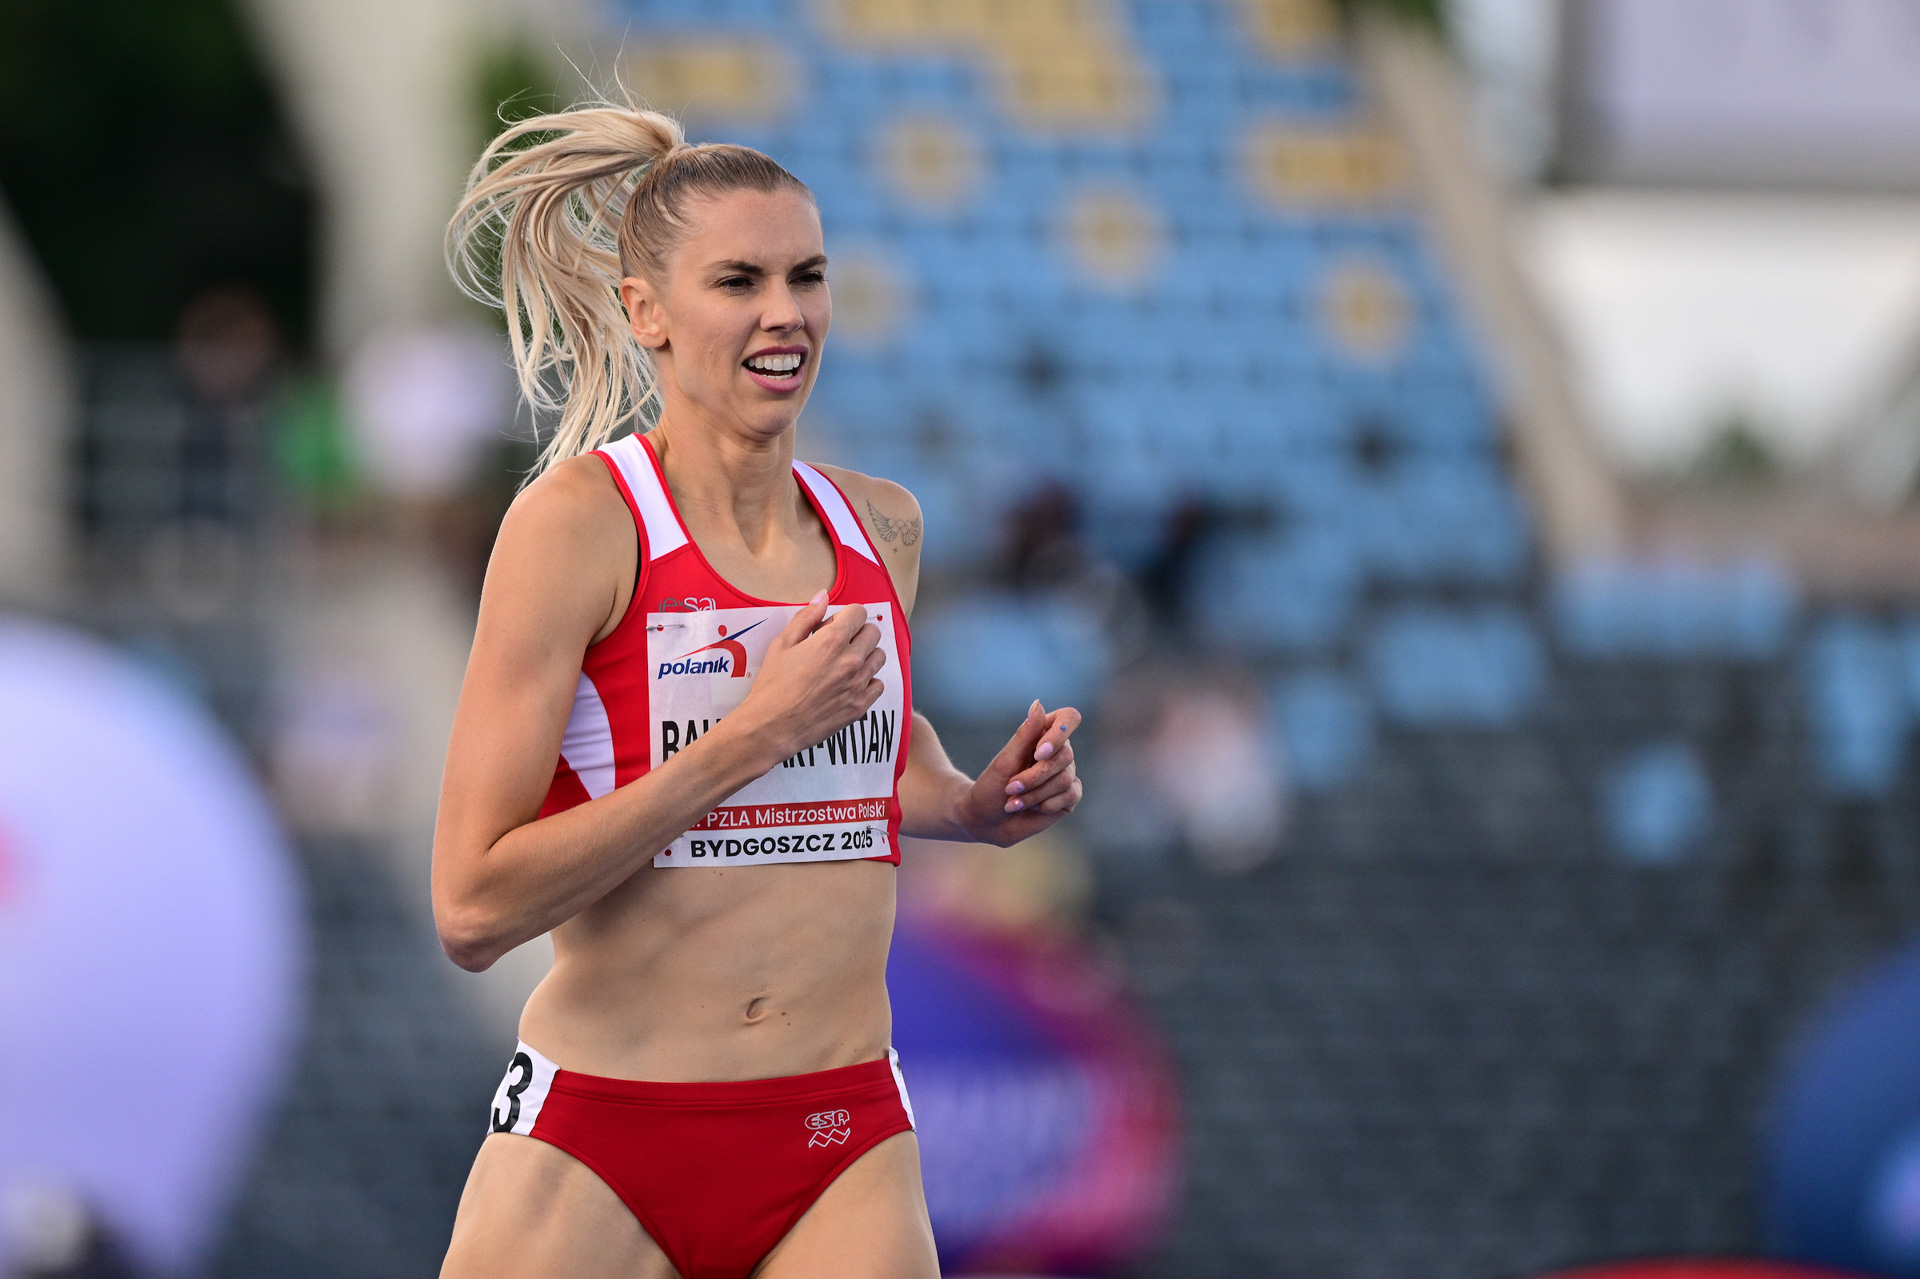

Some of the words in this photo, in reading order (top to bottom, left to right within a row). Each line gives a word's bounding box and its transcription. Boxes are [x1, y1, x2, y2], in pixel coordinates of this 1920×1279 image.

[658, 656, 730, 680] polanik
[707, 810, 751, 828] PZLA
[755, 805, 857, 825] Mistrzostwa
[858, 800, 885, 819] Polski
[690, 833, 835, 858] BYDGOSZCZ
[841, 830, 873, 850] 2025
[493, 1052, 533, 1133] 3
